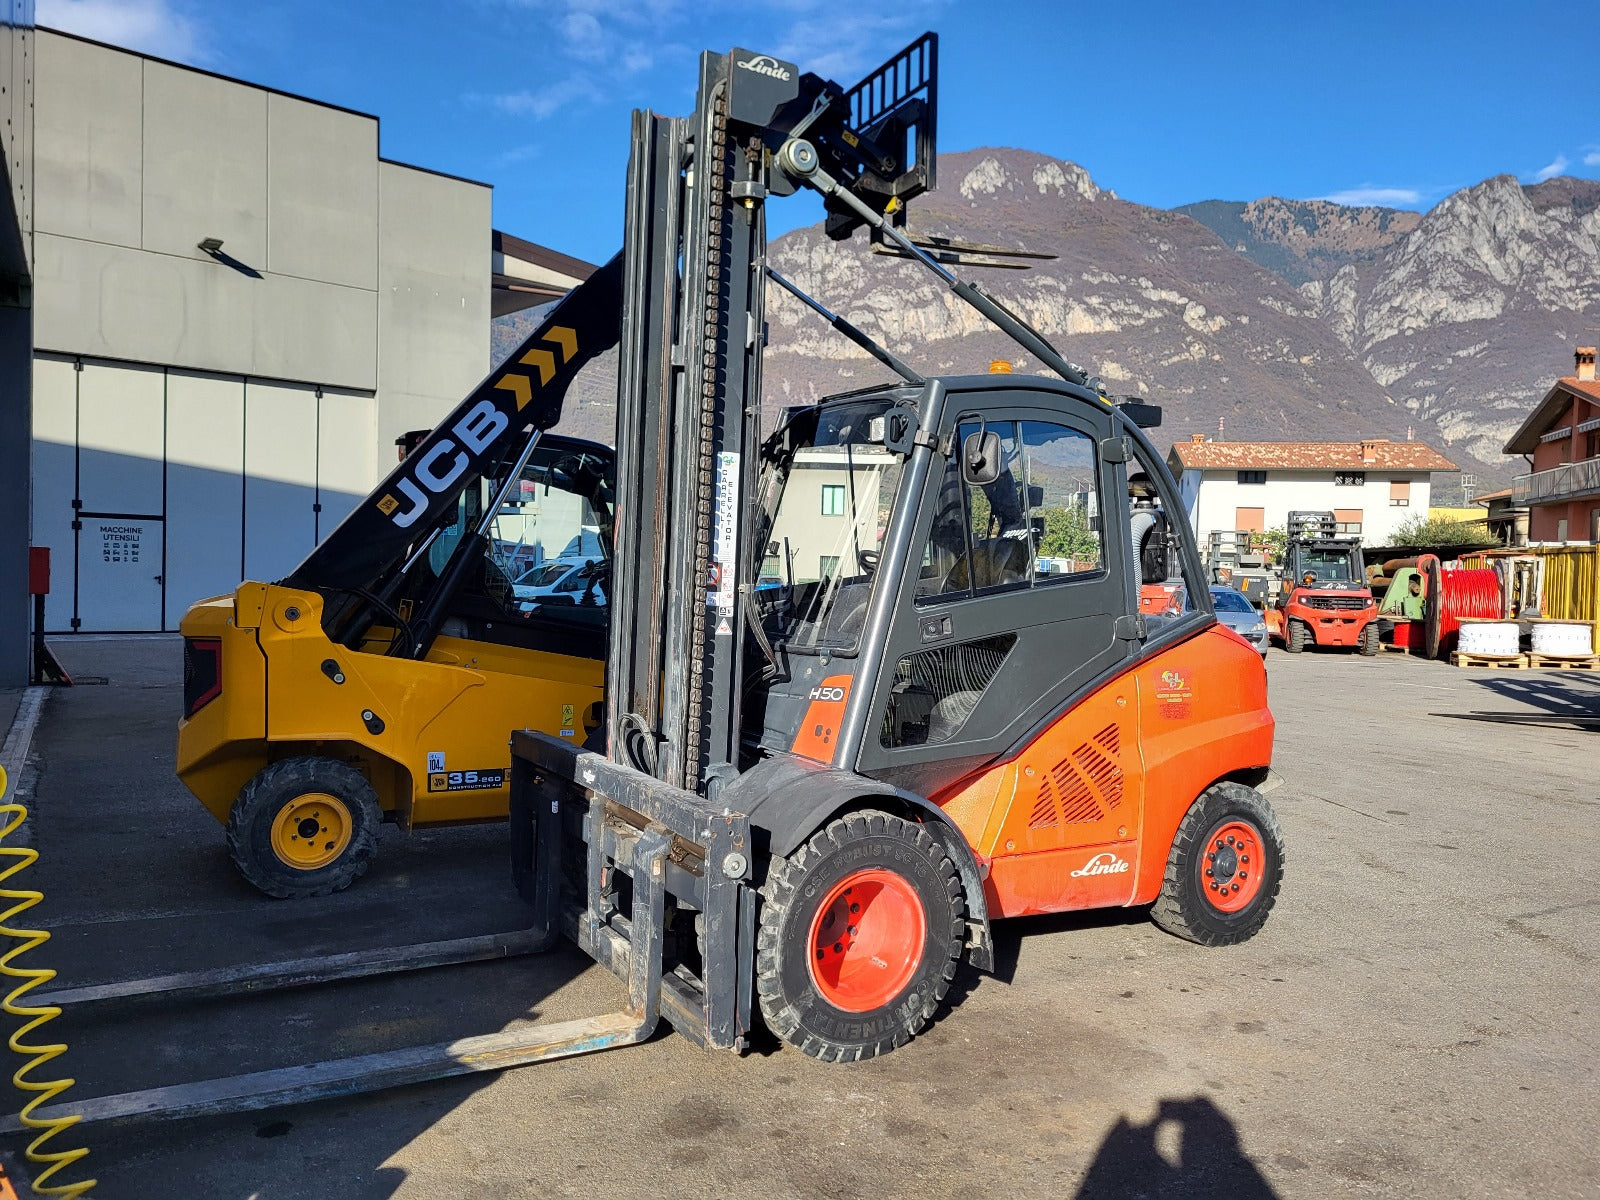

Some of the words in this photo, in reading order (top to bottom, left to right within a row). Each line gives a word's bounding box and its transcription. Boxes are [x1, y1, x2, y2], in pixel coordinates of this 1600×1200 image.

[736, 55, 791, 82] Linde
[391, 399, 509, 528] JCB
[100, 526, 144, 534] MACCHINE
[103, 534, 140, 542] UTENSILI
[808, 687, 844, 701] H50
[429, 758, 440, 771] 104
[1070, 853, 1130, 878] Linde
